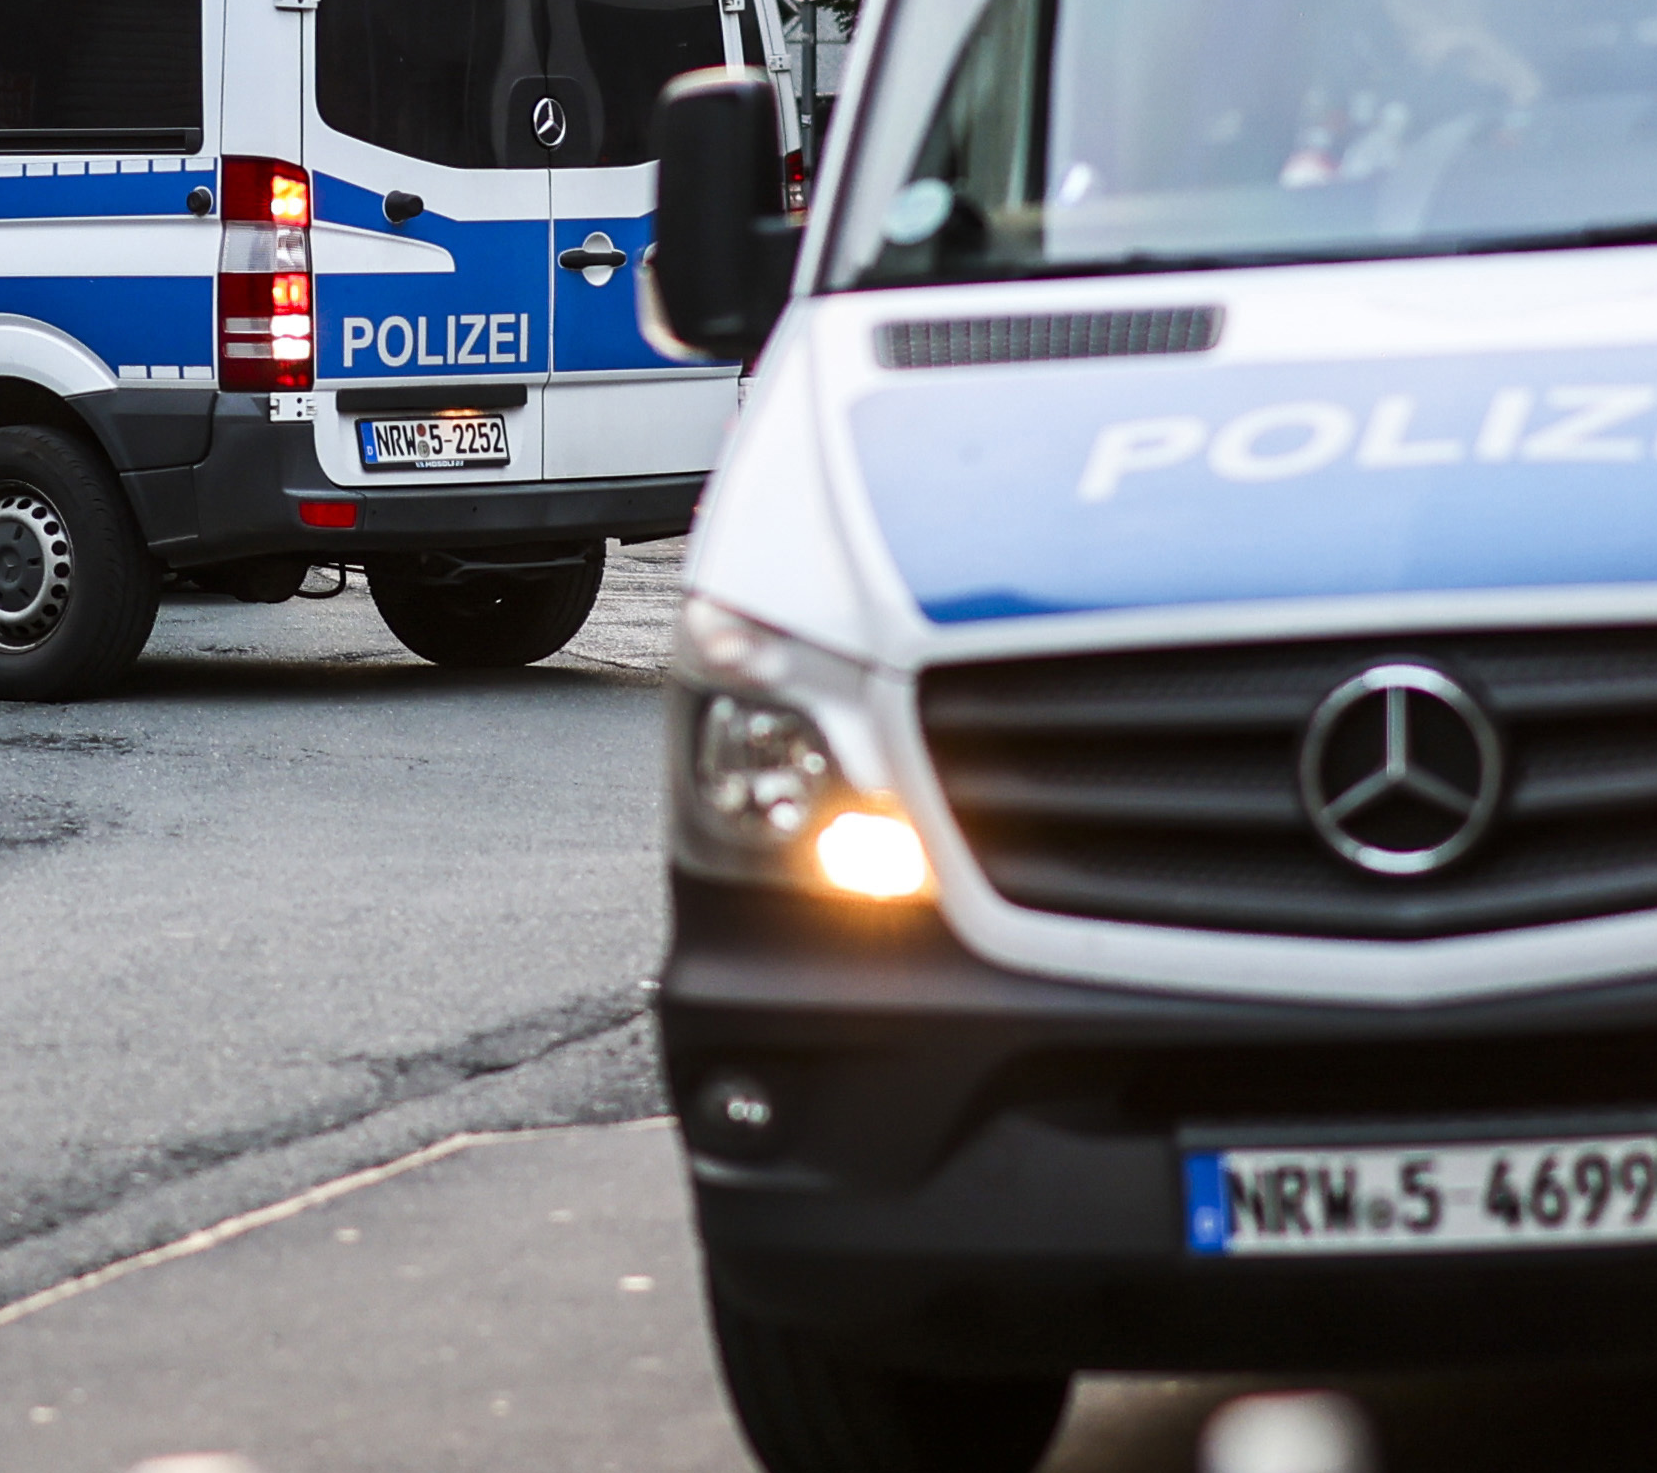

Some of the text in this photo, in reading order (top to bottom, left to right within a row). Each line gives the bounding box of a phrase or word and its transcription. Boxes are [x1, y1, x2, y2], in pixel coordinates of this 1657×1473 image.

[342, 313, 529, 367] POLIZEI
[375, 424, 417, 457] NRW
[428, 422, 505, 455] 5-2252
[1227, 1164, 1358, 1236] NRW
